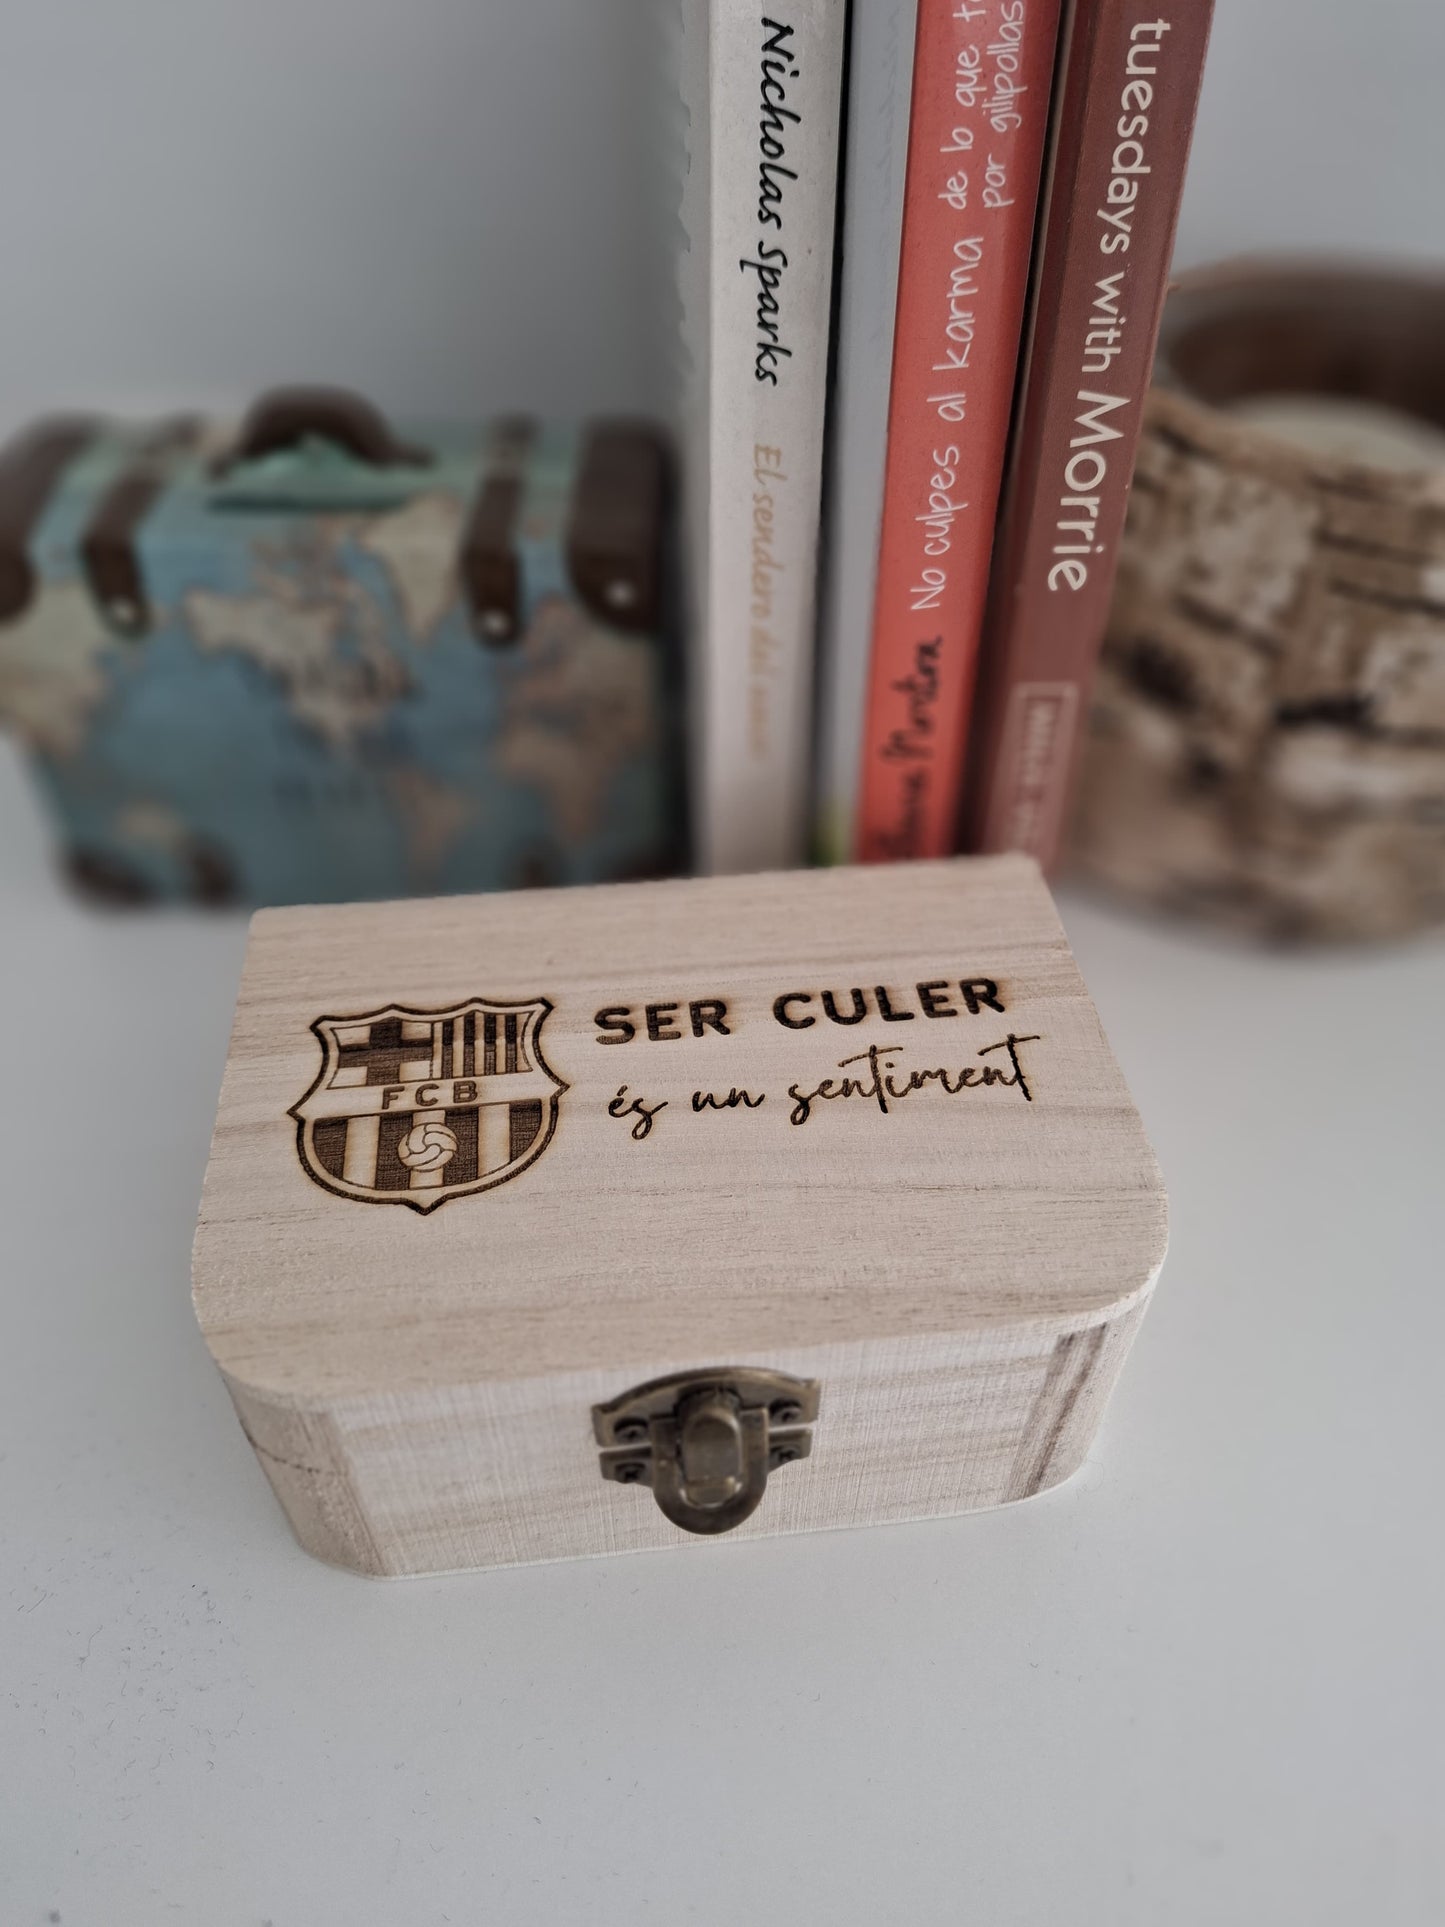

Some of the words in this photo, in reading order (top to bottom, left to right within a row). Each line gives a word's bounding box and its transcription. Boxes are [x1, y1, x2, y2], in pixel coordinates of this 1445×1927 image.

[952, 0, 987, 22] t
[955, 44, 988, 107] que
[982, 0, 1028, 133] gilipollas
[758, 16, 801, 231] Nicholas
[939, 126, 974, 153] lo
[1097, 18, 1172, 254] tuesdays
[937, 170, 969, 210] de
[983, 154, 1014, 209] por
[932, 236, 984, 371] karma
[1081, 270, 1126, 373] with
[926, 392, 967, 423] al
[752, 442, 788, 488] El
[915, 444, 969, 556] culpes
[1047, 390, 1132, 592] Morrie
[750, 492, 785, 624] sendero
[910, 568, 947, 611] No
[593, 997, 732, 1046] SER
[772, 976, 1006, 1031] CULER
[382, 1080, 479, 1112] FCB
[606, 1083, 669, 1140] és
[691, 1087, 766, 1114] un
[787, 1033, 1042, 1126] sentiment
